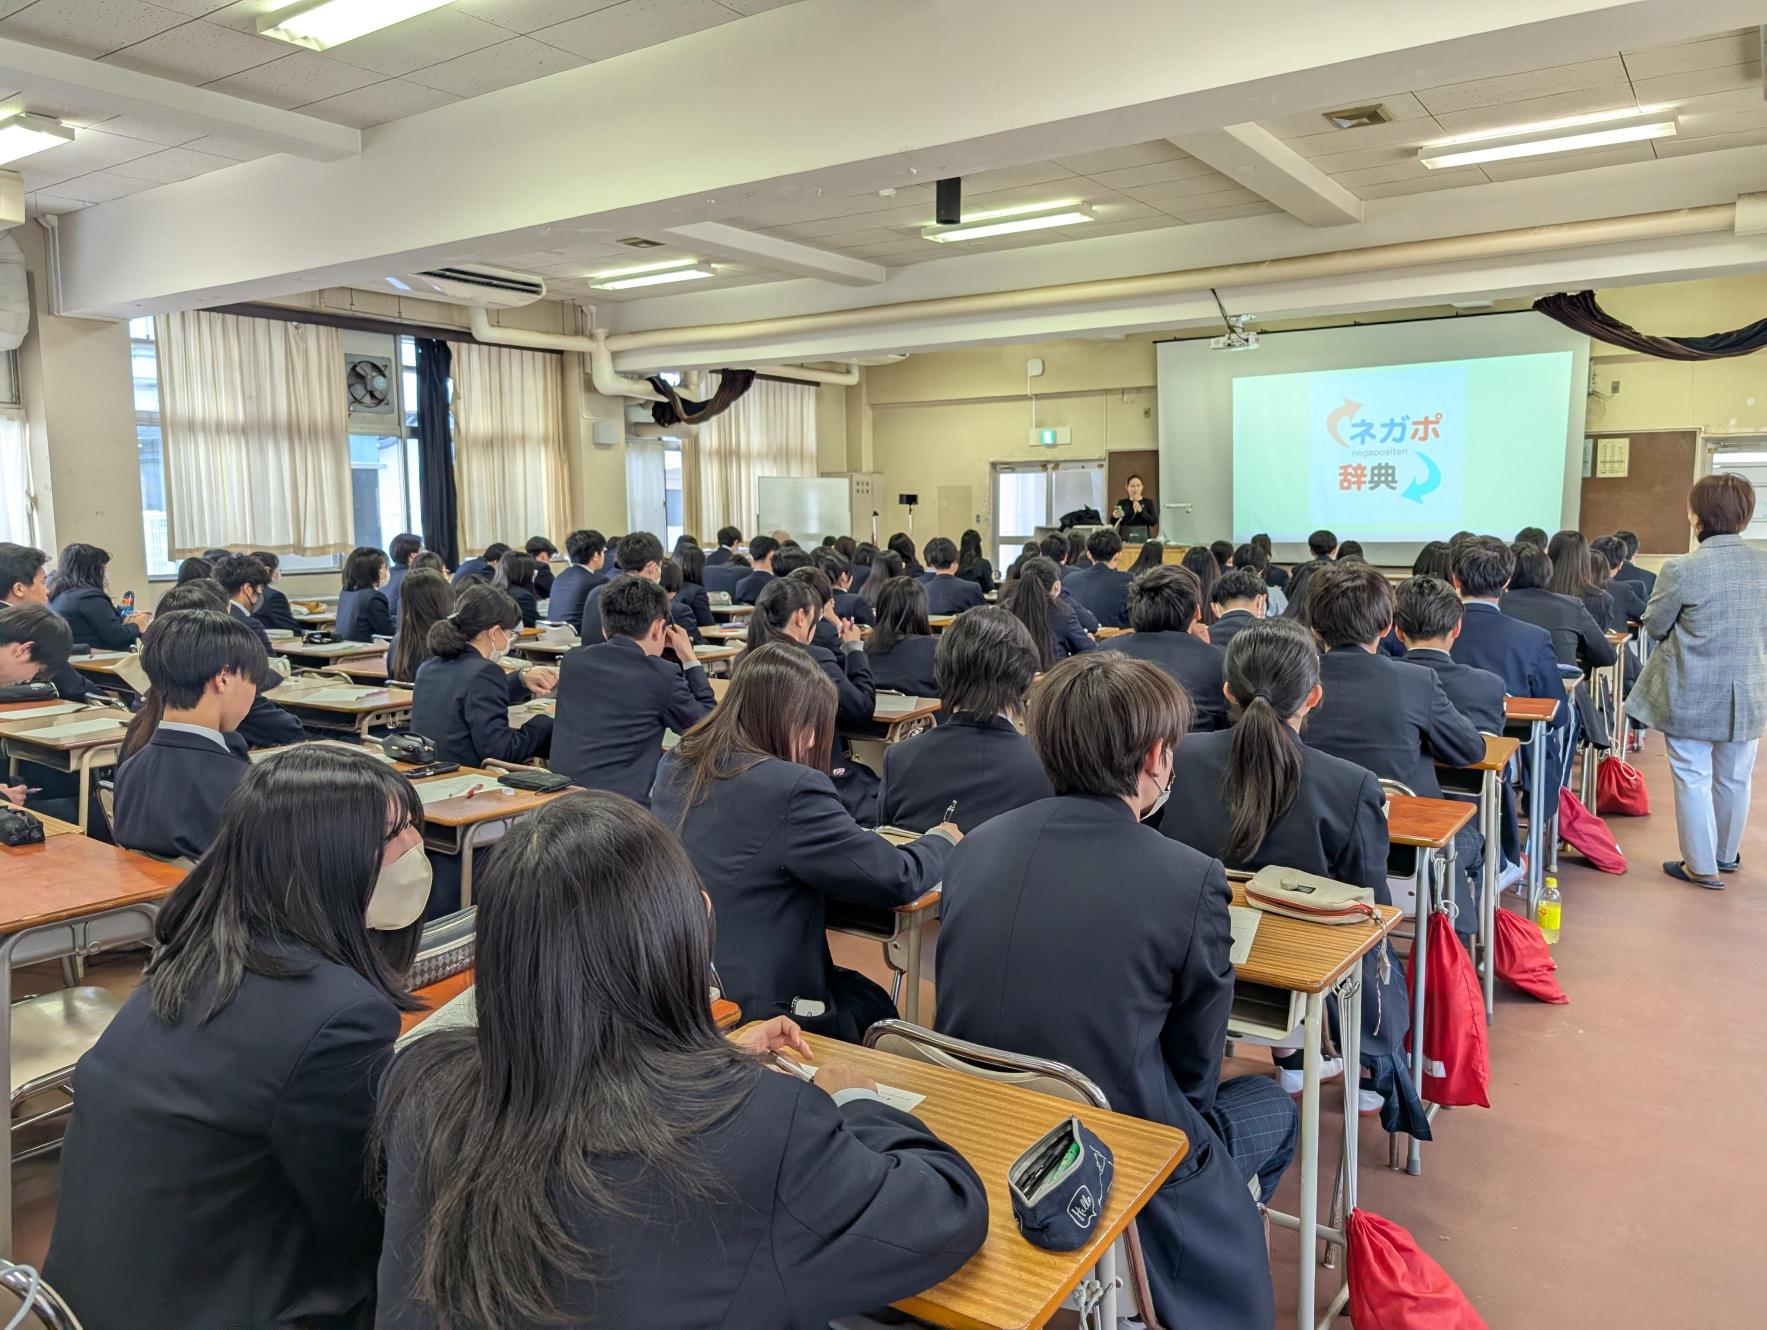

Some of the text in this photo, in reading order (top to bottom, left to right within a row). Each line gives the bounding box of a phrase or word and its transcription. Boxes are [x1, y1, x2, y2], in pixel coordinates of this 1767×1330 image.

[1349, 412, 1443, 446] ネガポ
[1338, 462, 1398, 491] 辞典
